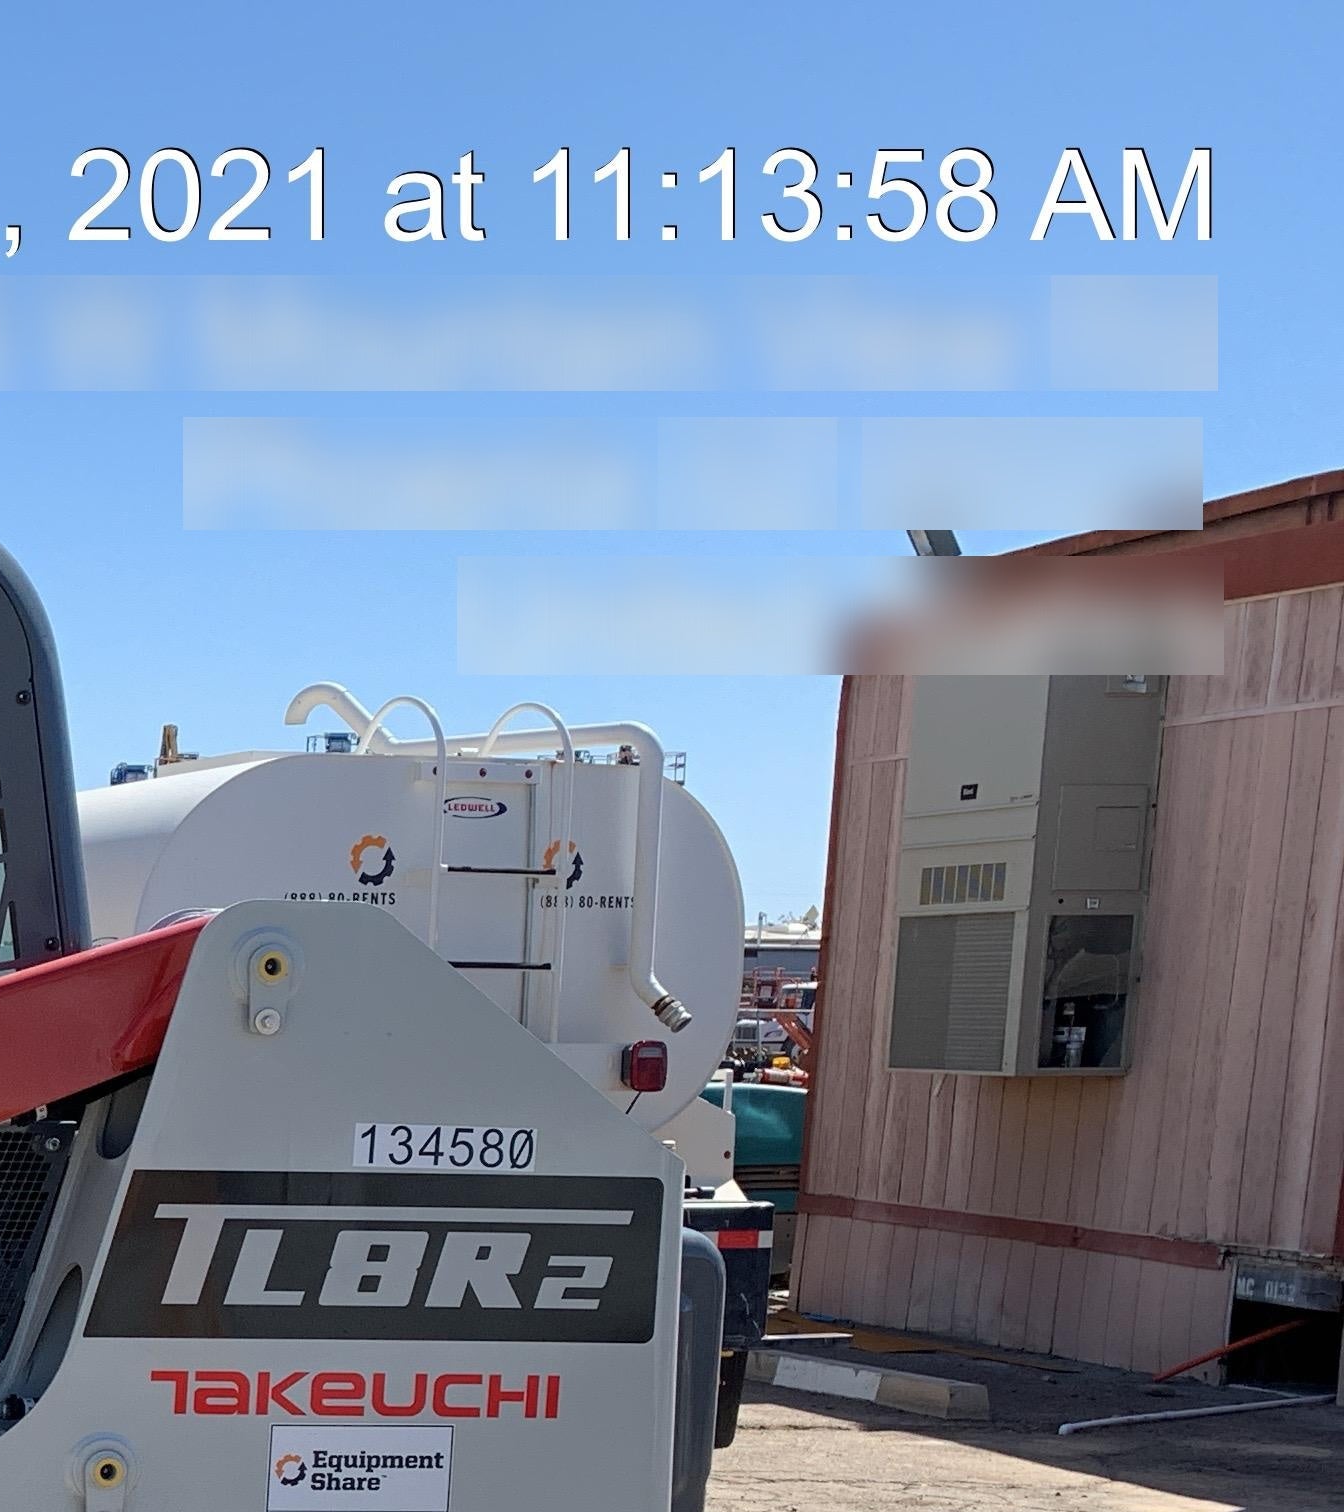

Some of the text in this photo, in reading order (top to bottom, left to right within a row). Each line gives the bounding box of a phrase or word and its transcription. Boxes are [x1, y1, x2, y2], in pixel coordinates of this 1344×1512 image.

[446, 802, 497, 814] LEDWELL
[359, 1124, 534, 1169] 134580
[153, 1203, 634, 1311] TL8R2
[311, 1450, 445, 1472] Equipment
[311, 1473, 382, 1491] Share
